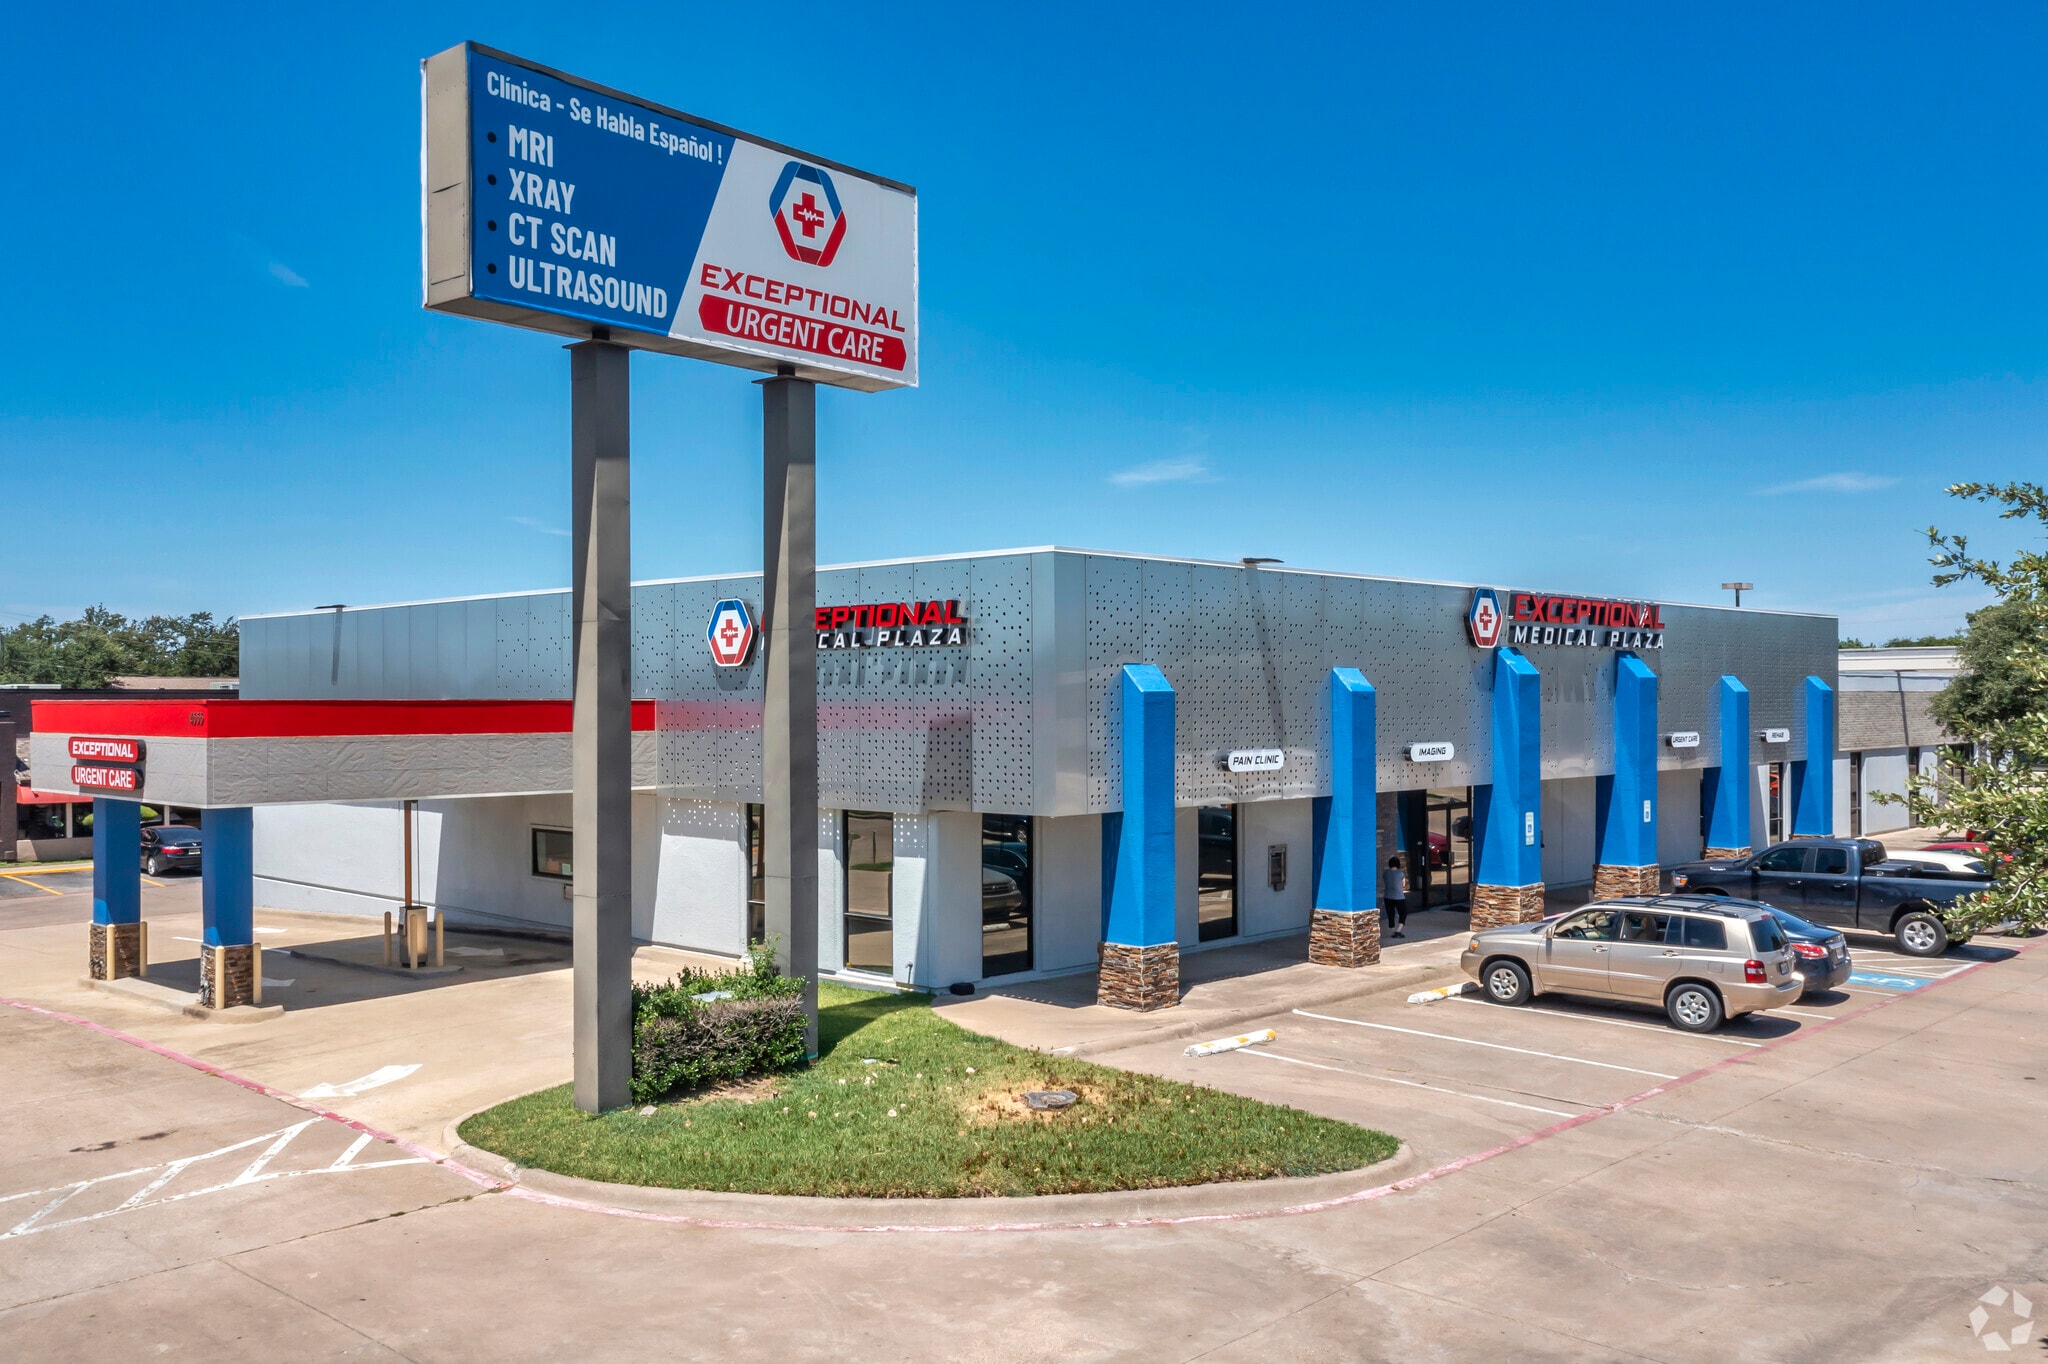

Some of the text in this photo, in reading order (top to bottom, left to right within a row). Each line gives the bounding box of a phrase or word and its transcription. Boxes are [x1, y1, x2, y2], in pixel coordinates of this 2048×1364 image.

[487, 71, 551, 112] Clínica
[570, 97, 592, 124] Se
[597, 106, 645, 142] Habla
[650, 122, 713, 163] Español
[508, 124, 554, 168] MRI
[508, 167, 576, 215] XRAY
[508, 212, 616, 267] CT SCAN
[508, 255, 668, 319] ULTRASOUND
[700, 263, 906, 333] EXCEPTIONAL
[726, 304, 885, 363] URGENT CARE
[761, 600, 963, 632] EPTIONAL
[1514, 593, 1665, 630] EXCEPTIONAL
[877, 628, 962, 648] PLAZA
[1514, 625, 1664, 649] MEDICAL PLAZA
[72, 741, 134, 758] EXCEPTIONAL
[1232, 754, 1279, 766] PAIN CLINIC
[1418, 746, 1446, 756] IMAGING
[74, 766, 132, 788] URGENT CARE
